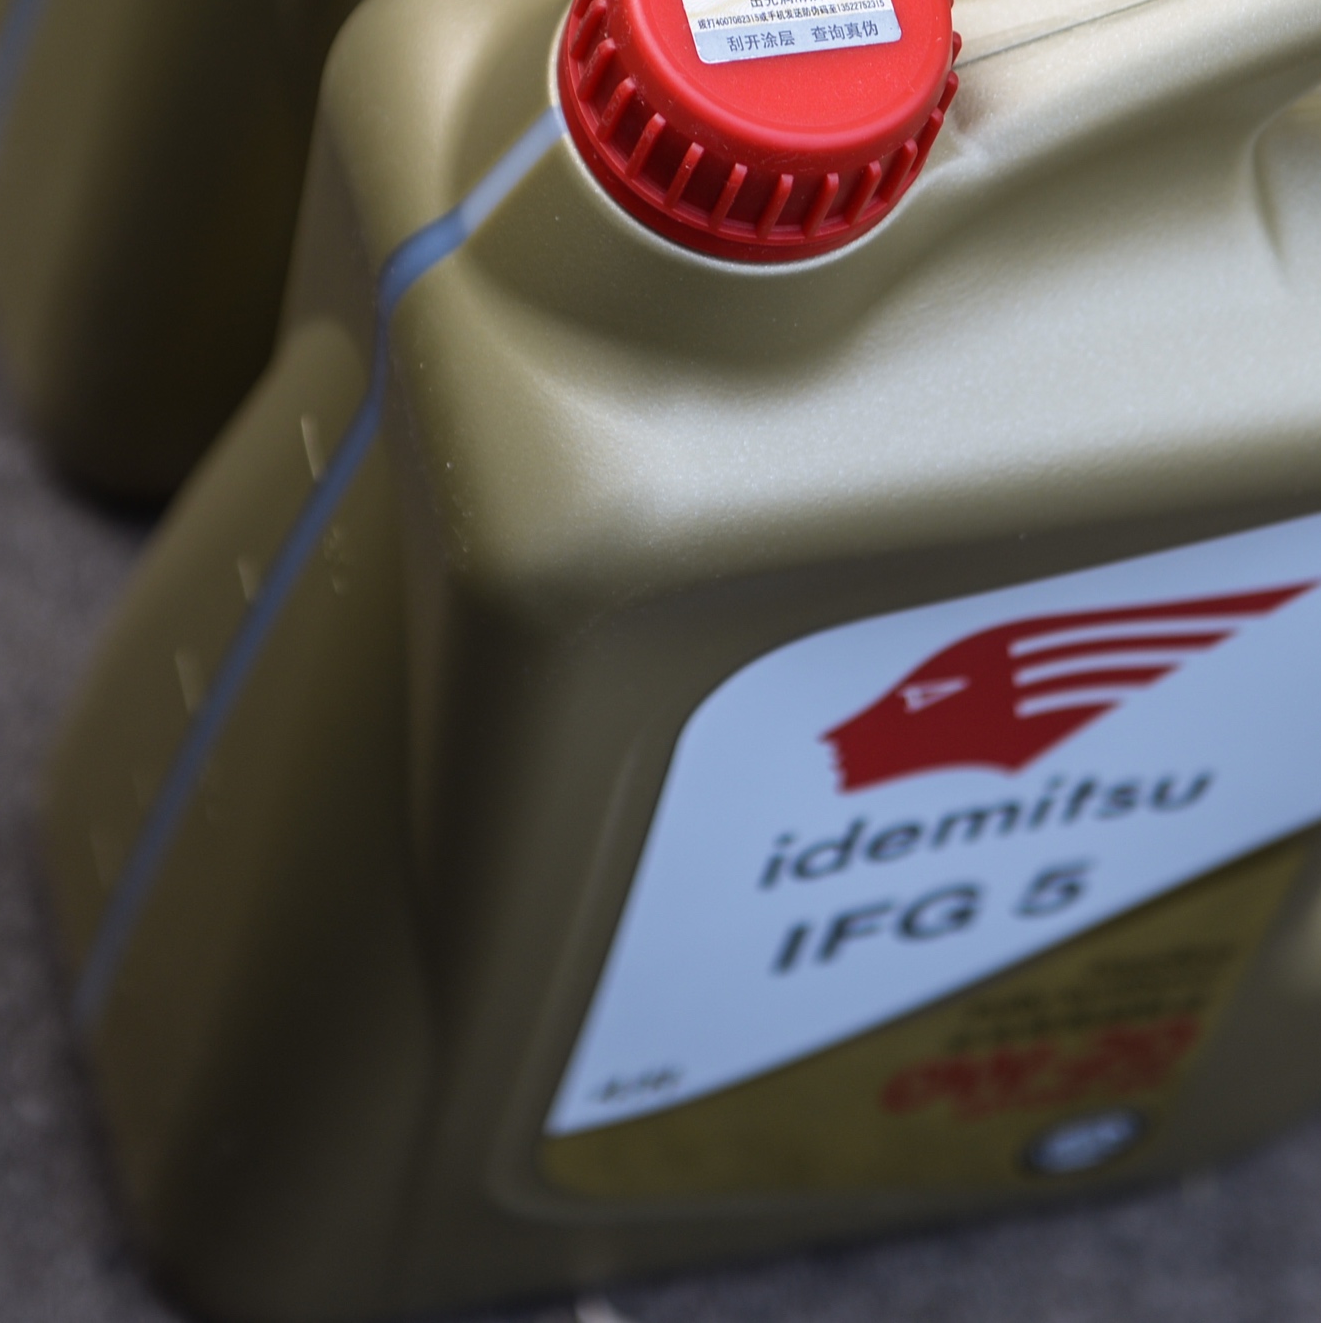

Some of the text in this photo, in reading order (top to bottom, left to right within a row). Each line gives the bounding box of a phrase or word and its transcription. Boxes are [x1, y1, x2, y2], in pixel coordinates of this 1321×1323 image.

[726, 22, 879, 52] 刮开涂层 查询真伪
[758, 769, 1215, 890] idemitsu
[770, 858, 1091, 976] IFG 5
